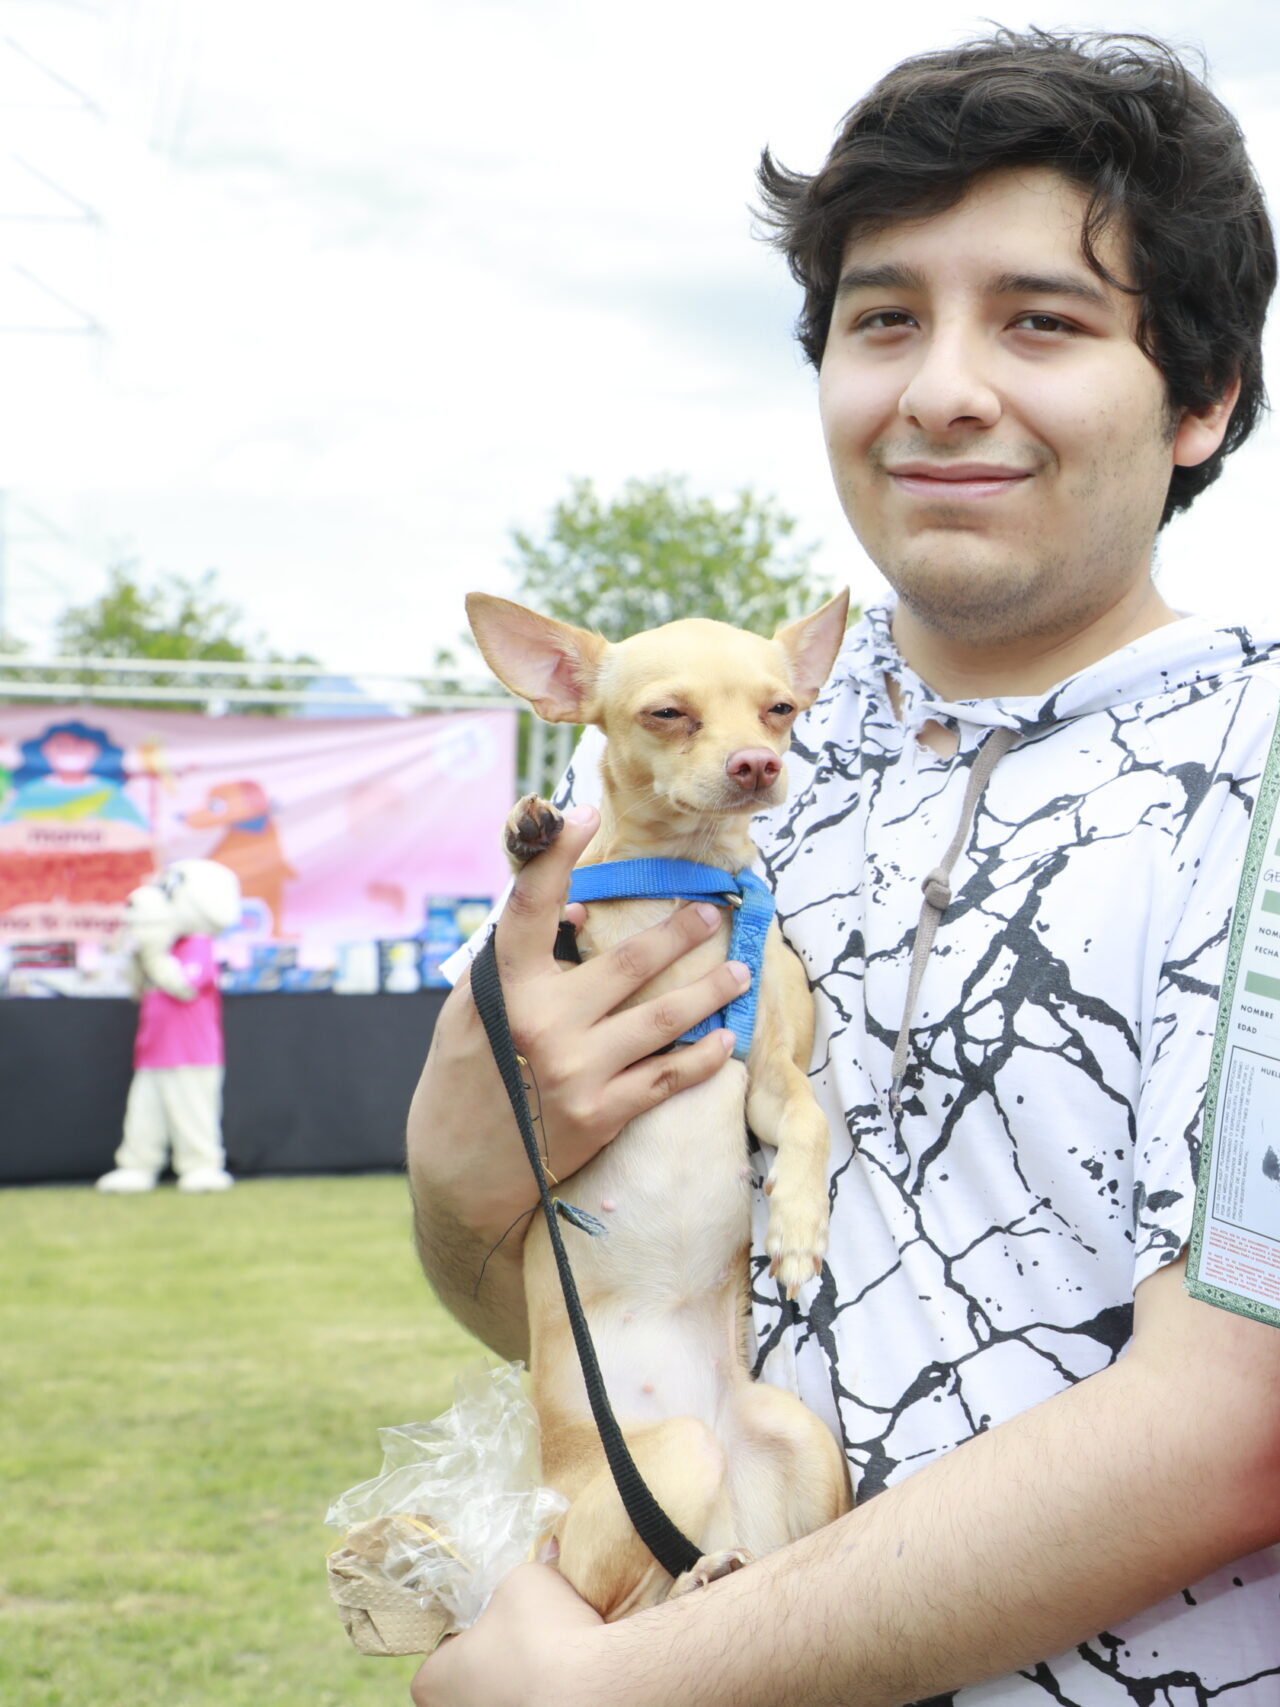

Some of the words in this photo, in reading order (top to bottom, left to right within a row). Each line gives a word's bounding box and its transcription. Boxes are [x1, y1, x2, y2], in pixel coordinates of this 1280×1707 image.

[1254, 945, 1279, 959] FECHA
[1240, 1003, 1275, 1020] NOMBRE
[1236, 1022, 1258, 1035] EDAD
